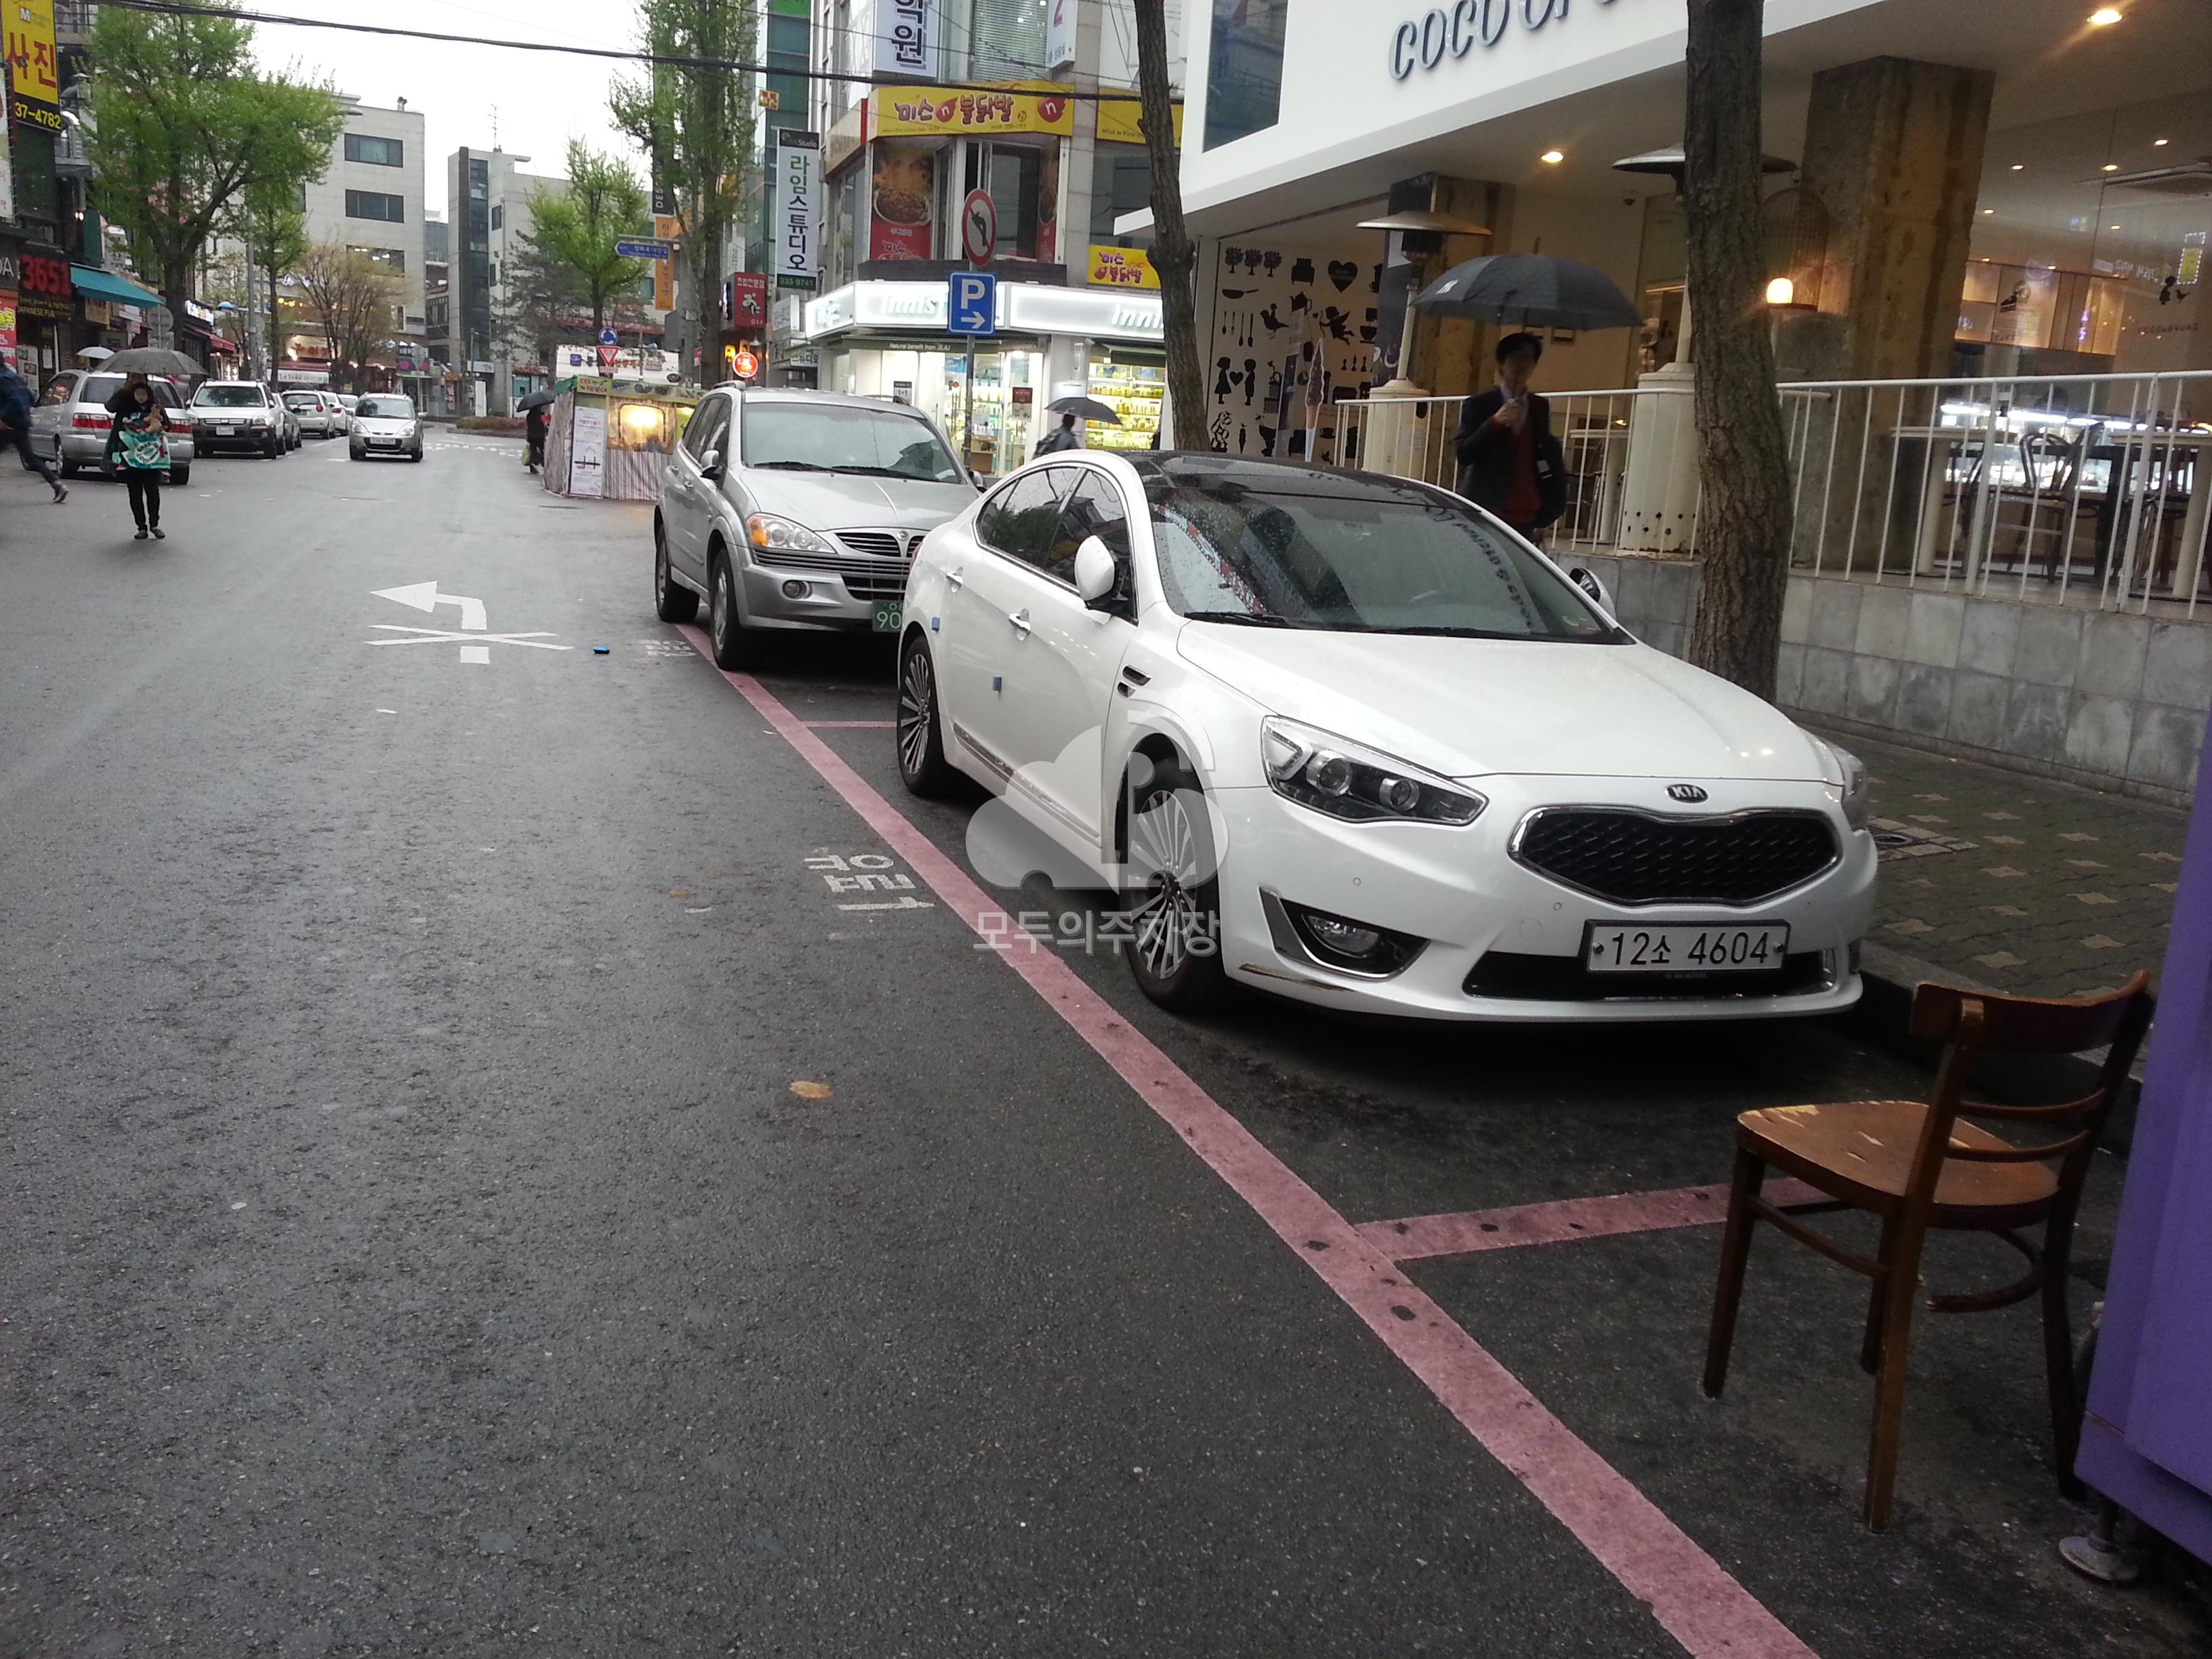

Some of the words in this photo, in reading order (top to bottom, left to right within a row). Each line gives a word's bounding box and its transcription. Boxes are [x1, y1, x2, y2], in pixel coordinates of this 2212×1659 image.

[5, 31, 57, 88] 사진
[894, 97, 935, 122] 미스
[787, 155, 810, 271] 라임스튜디오
[1099, 252, 1124, 265] 미스
[960, 279, 985, 310] P
[876, 611, 901, 629] 90
[1671, 786, 1703, 799] KIA
[1612, 932, 1672, 965] 12소
[1687, 931, 1769, 965] 4604
